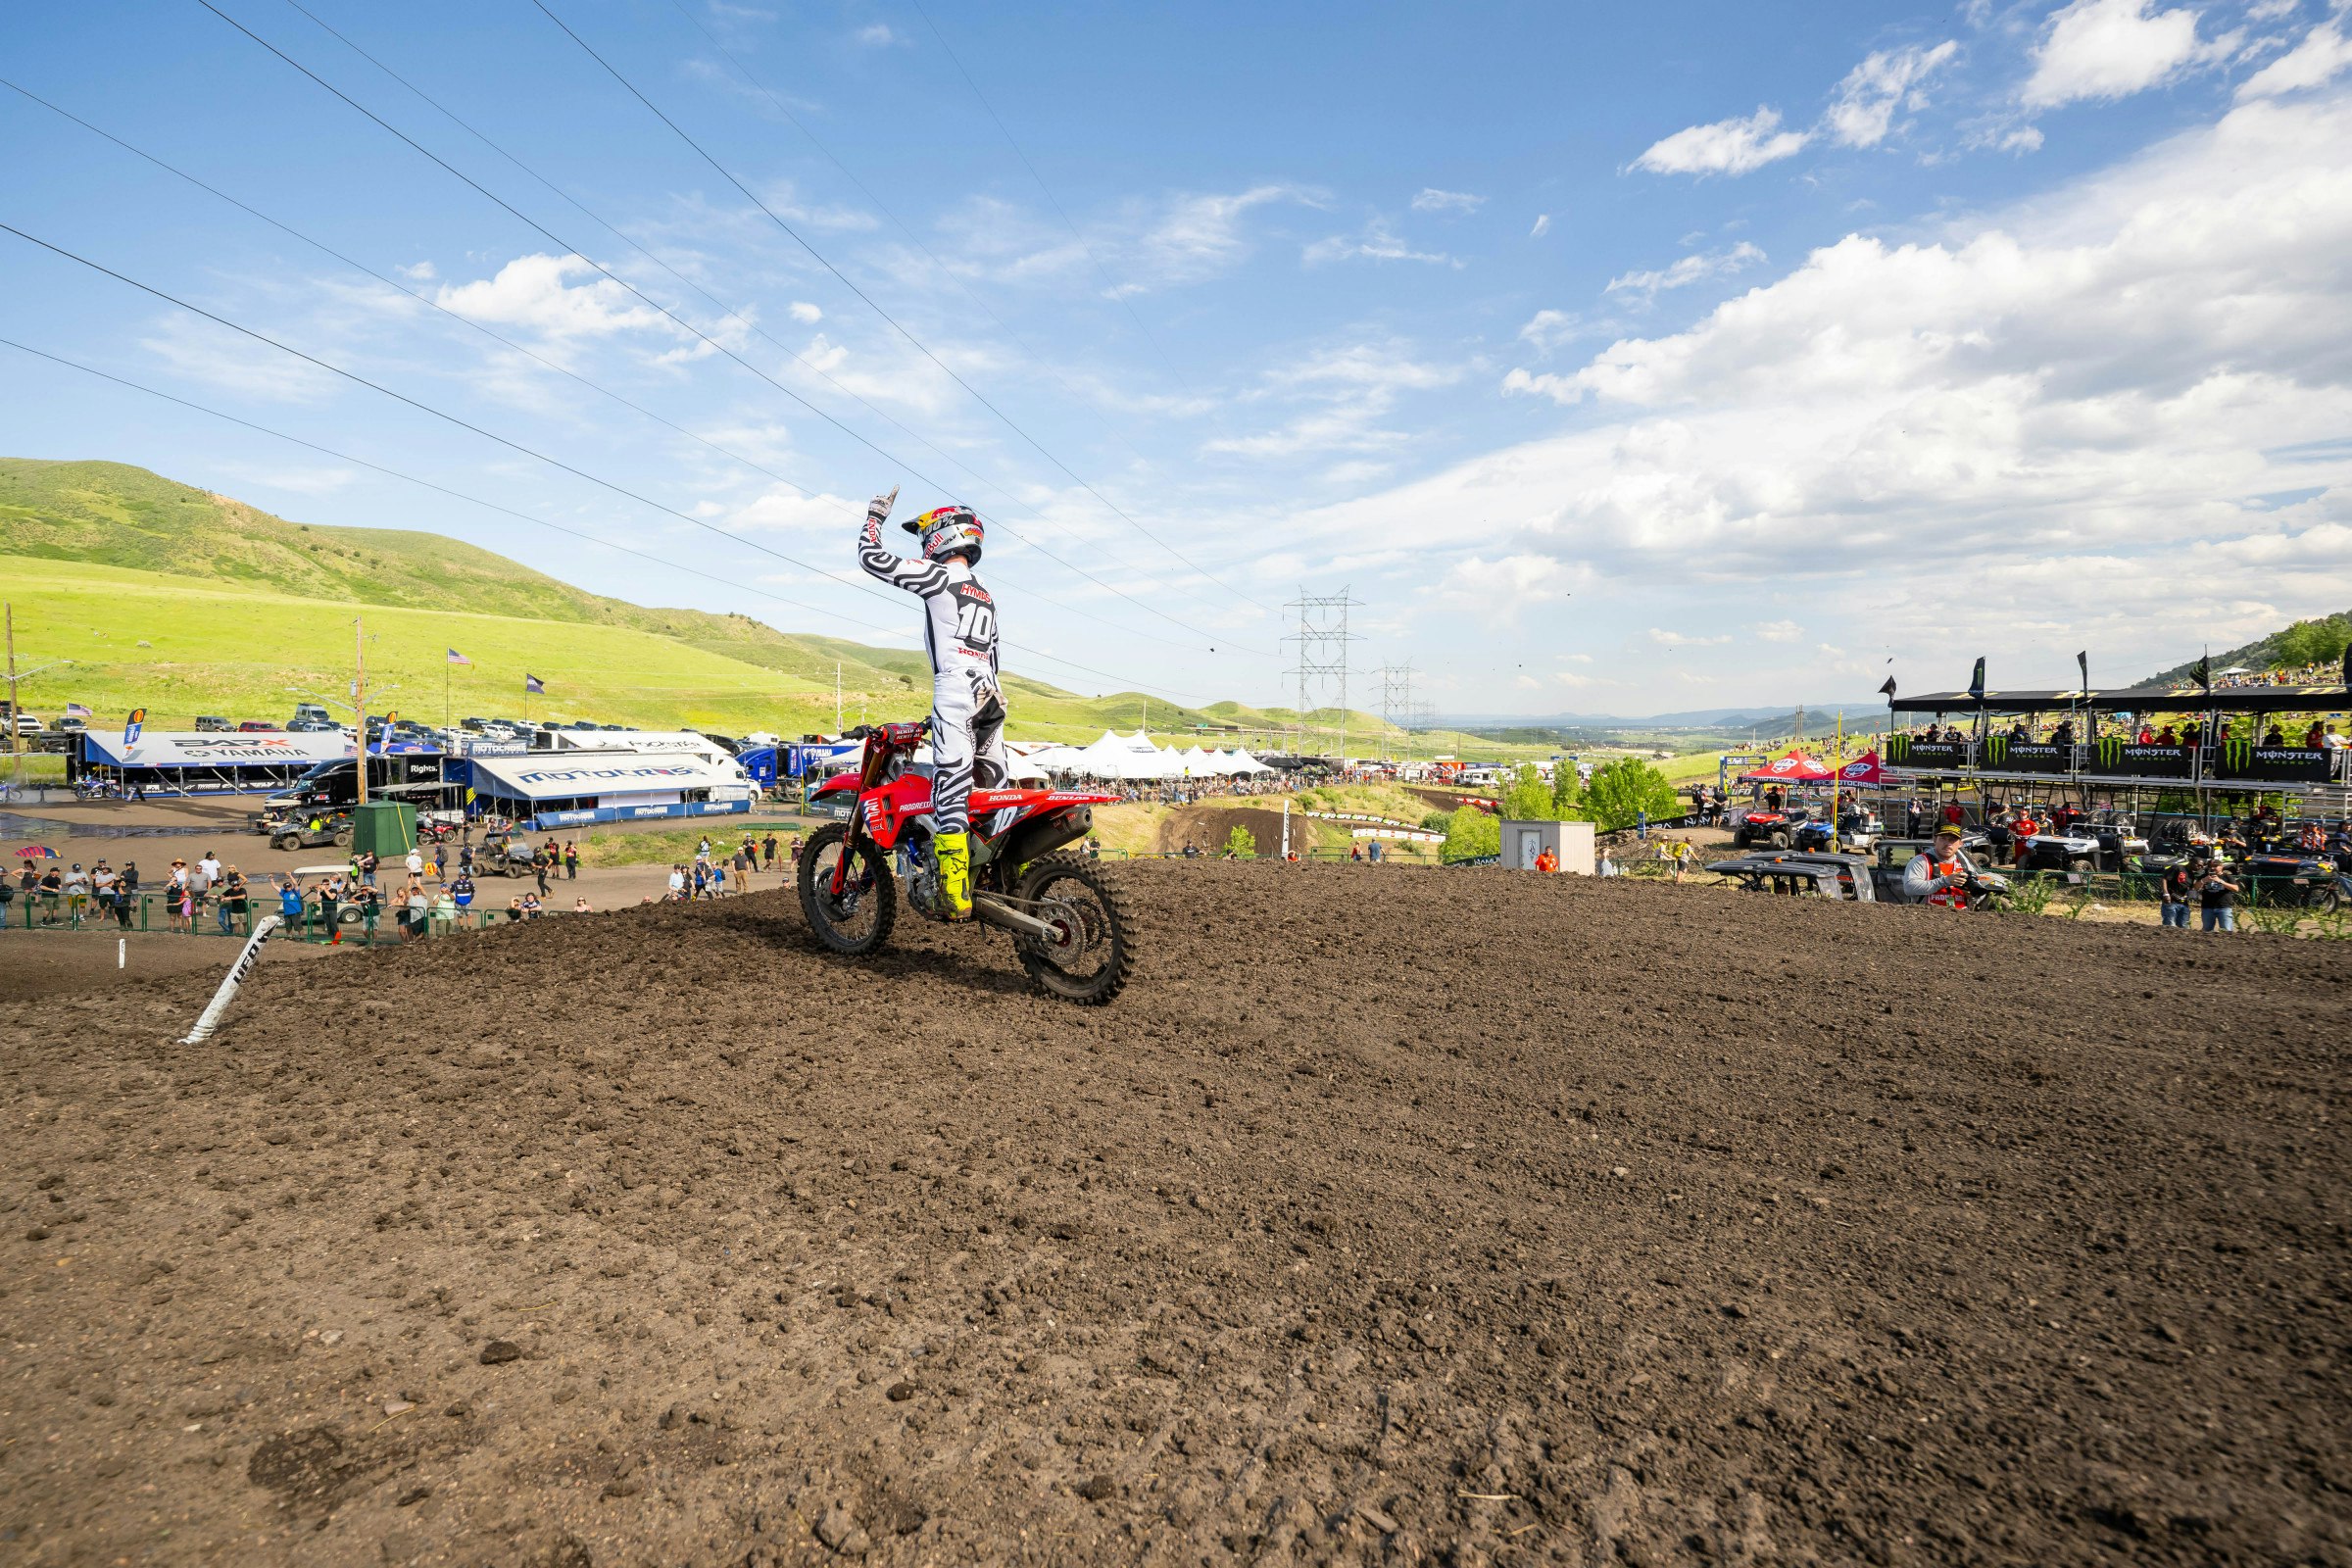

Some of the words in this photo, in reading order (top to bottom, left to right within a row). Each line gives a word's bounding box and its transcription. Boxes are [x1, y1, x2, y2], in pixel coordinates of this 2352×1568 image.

[960, 583, 992, 605] HYMAS
[956, 602, 993, 644] 10
[214, 748, 310, 757] YAMAHA
[2010, 746, 2058, 755] MONSTER
[2125, 748, 2181, 757] MONSTER
[2256, 751, 2324, 760] MONSTER
[411, 764, 438, 774] Rights.
[991, 806, 1018, 836] 10
[233, 943, 260, 985] UFO
